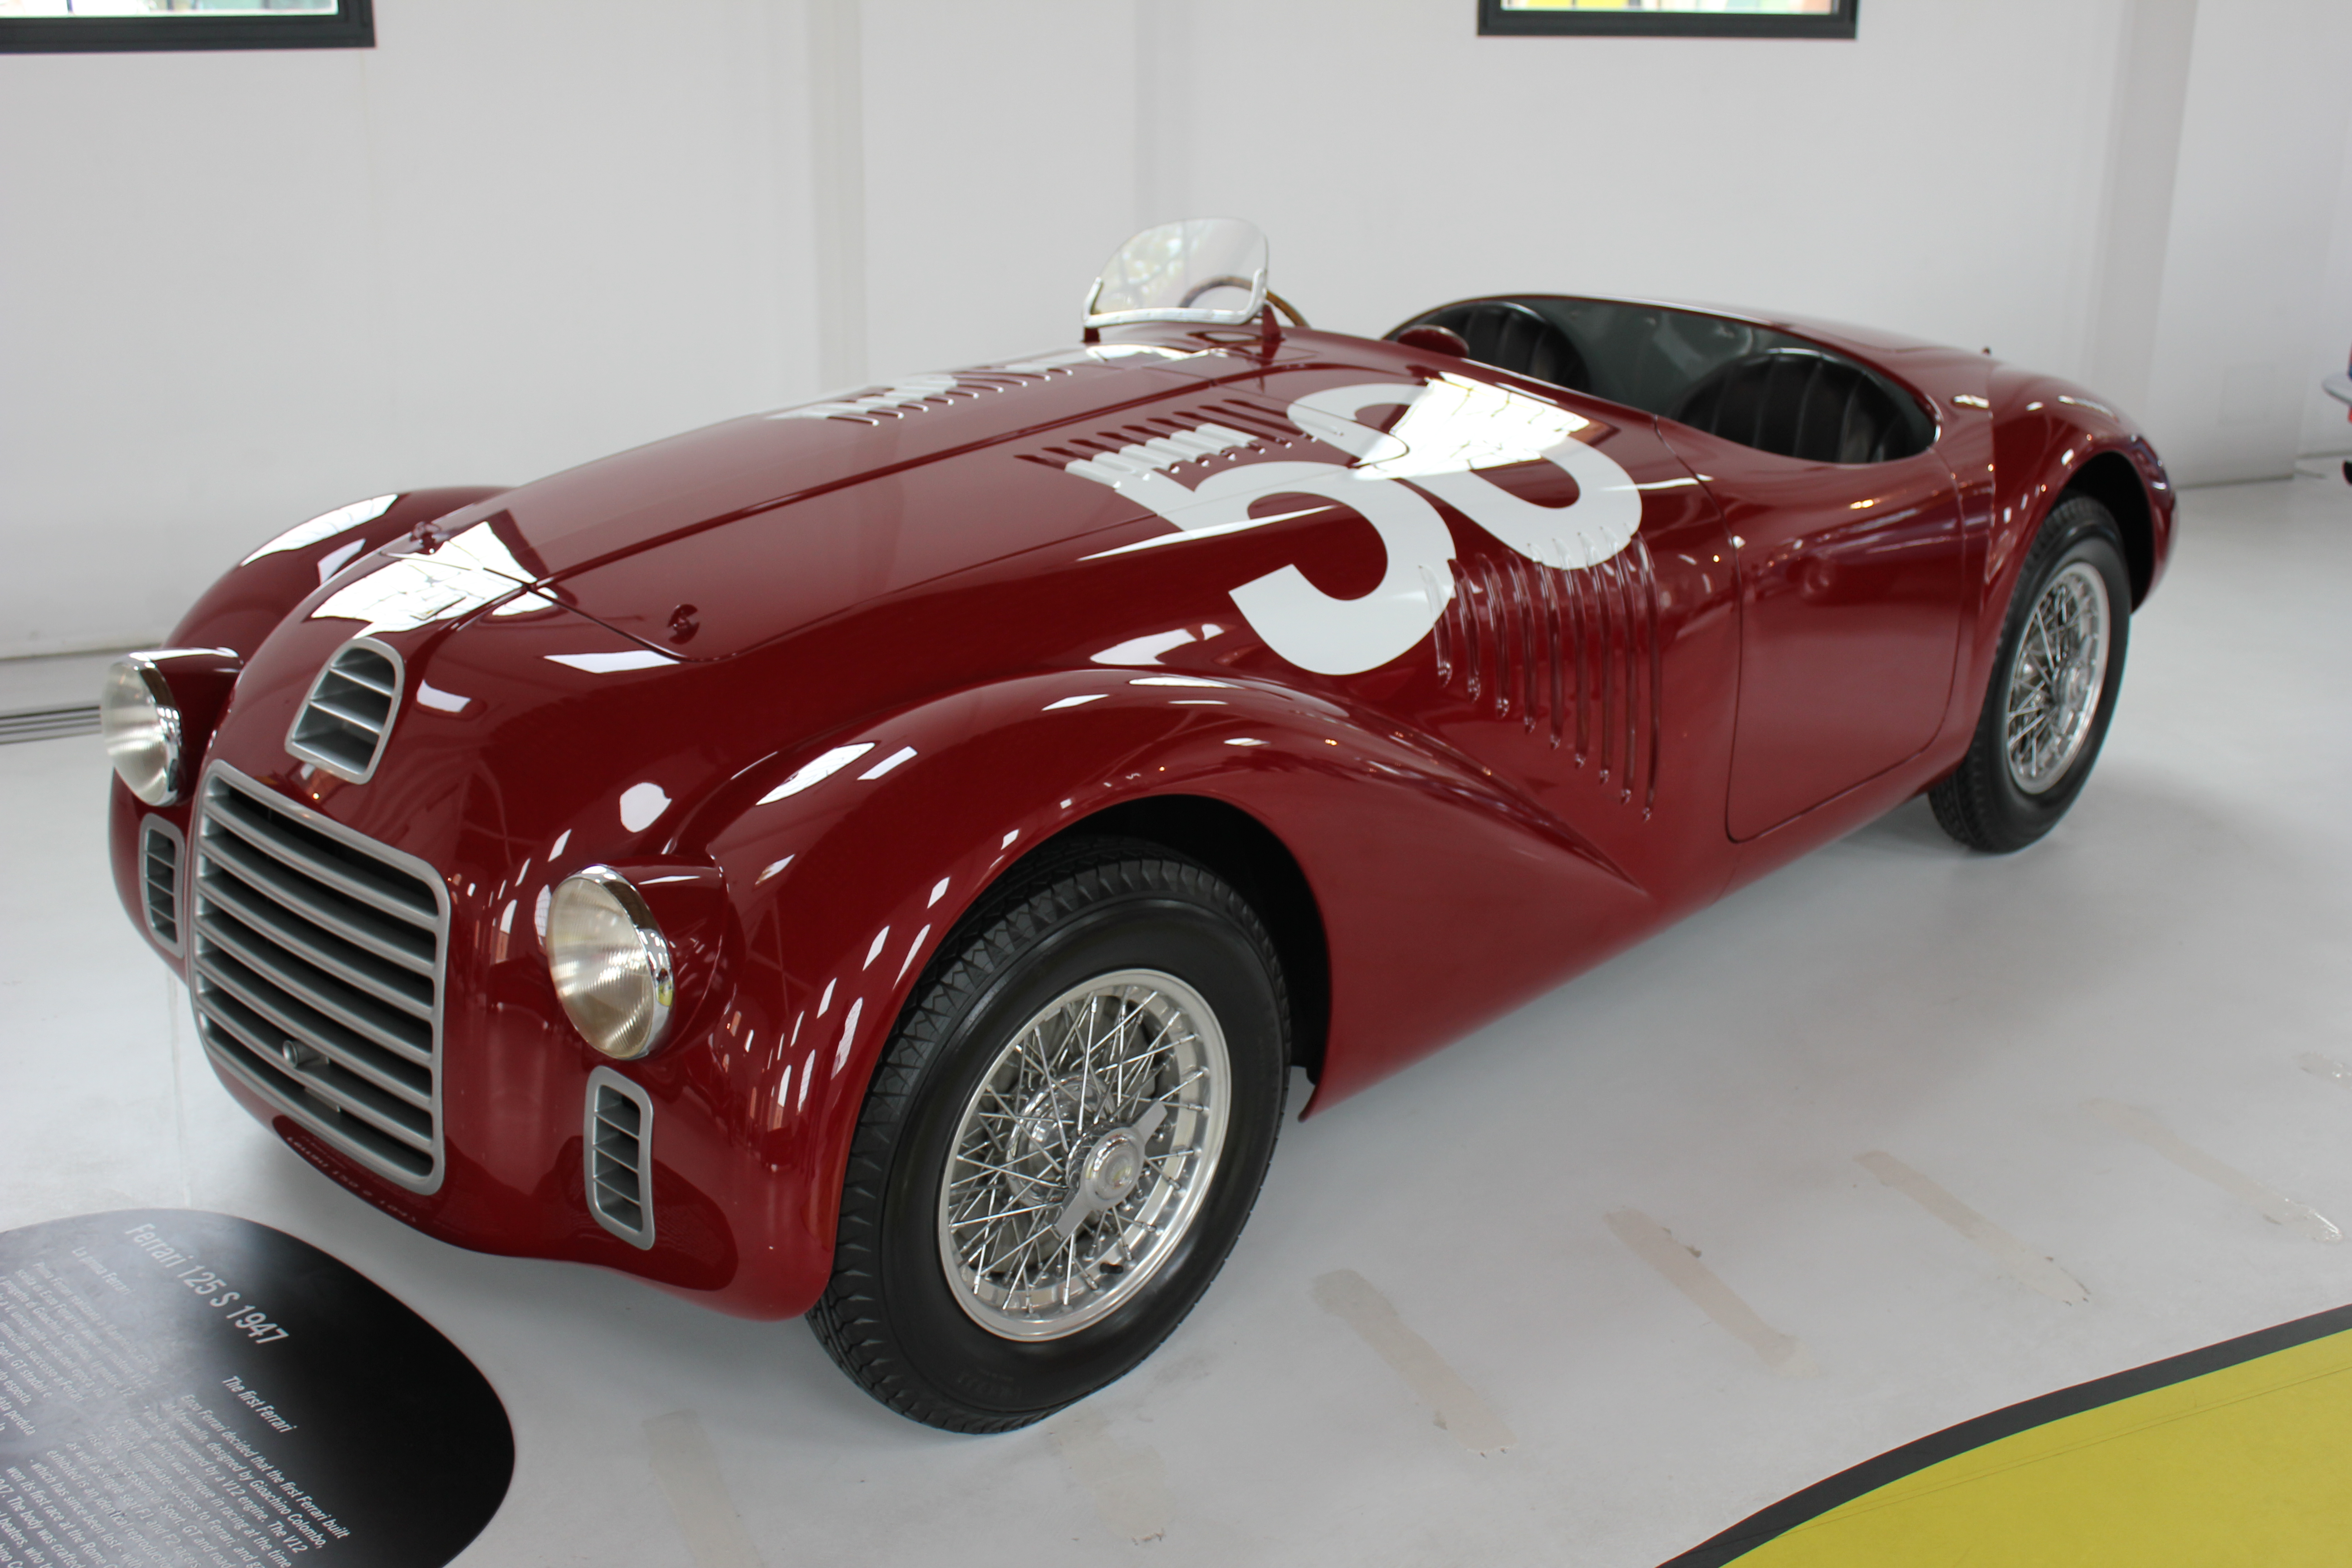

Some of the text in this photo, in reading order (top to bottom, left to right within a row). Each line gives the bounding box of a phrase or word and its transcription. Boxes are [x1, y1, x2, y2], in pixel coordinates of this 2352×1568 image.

[71, 1246, 87, 1257] La
[102, 1272, 136, 1295] Ferrari
[124, 1223, 289, 1344] Ferrari 125 S 1947
[54, 1303, 78, 1323] Ferrari
[10, 1359, 28, 1370] GT
[19, 1369, 51, 1392] stradali
[26, 1350, 58, 1377] successo
[59, 1380, 88, 1402] Ferrari
[93, 1387, 106, 1398] ha
[119, 1386, 137, 1399] 12
[3, 1410, 36, 1436] perduta
[221, 1375, 298, 1432] The first Ferrari
[46, 1450, 86, 1480] exhibited
[76, 1478, 91, 1488] is
[142, 1410, 162, 1423] was
[157, 1422, 170, 1431] to
[164, 1429, 180, 1440] be
[172, 1439, 213, 1467] powered
[205, 1465, 220, 1476] by
[222, 1480, 245, 1496] V12
[237, 1496, 268, 1523] engine.
[267, 1520, 287, 1537] The
[283, 1534, 308, 1553] V12
[168, 1409, 209, 1443] Maranello,
[206, 1442, 247, 1472] designed
[238, 1470, 254, 1480] by
[249, 1480, 291, 1514] Gioachino
[287, 1513, 326, 1548] Colombo,
[180, 1393, 350, 1539] Enzo Ferrari decided that the first Ferrari built
[6, 1466, 107, 1565] won its first race at the Rome
[30, 1462, 58, 1484] which
[50, 1481, 69, 1496] has
[63, 1496, 88, 1515] since
[82, 1514, 106, 1534] been
[100, 1532, 123, 1548] lost
[65, 1442, 201, 1568] as well as single seat F1 and F2 racers
[83, 1487, 99, 1498] an
[85, 1432, 103, 1447] rise
[98, 1445, 113, 1454] to
[112, 1460, 155, 1496] succession
[150, 1495, 168, 1504] of
[182, 1524, 203, 1536] GT
[193, 1537, 219, 1552] and
[209, 1552, 236, 1568] road
[93, 1496, 134, 1529] identical
[105, 1424, 259, 1562] brought immediate success to Ferrari, and
[149, 1441, 177, 1462] which
[171, 1460, 190, 1475] was
[185, 1474, 216, 1498] unique
[210, 1496, 225, 1507] in
[219, 1506, 250, 1530] racing
[243, 1528, 261, 1538] at
[253, 1536, 272, 1551] the
[267, 1549, 291, 1568] time
[7, 1495, 25, 1511] The
[19, 1509, 44, 1529] body
[37, 1528, 57, 1544] was
[24, 1546, 44, 1563] who
